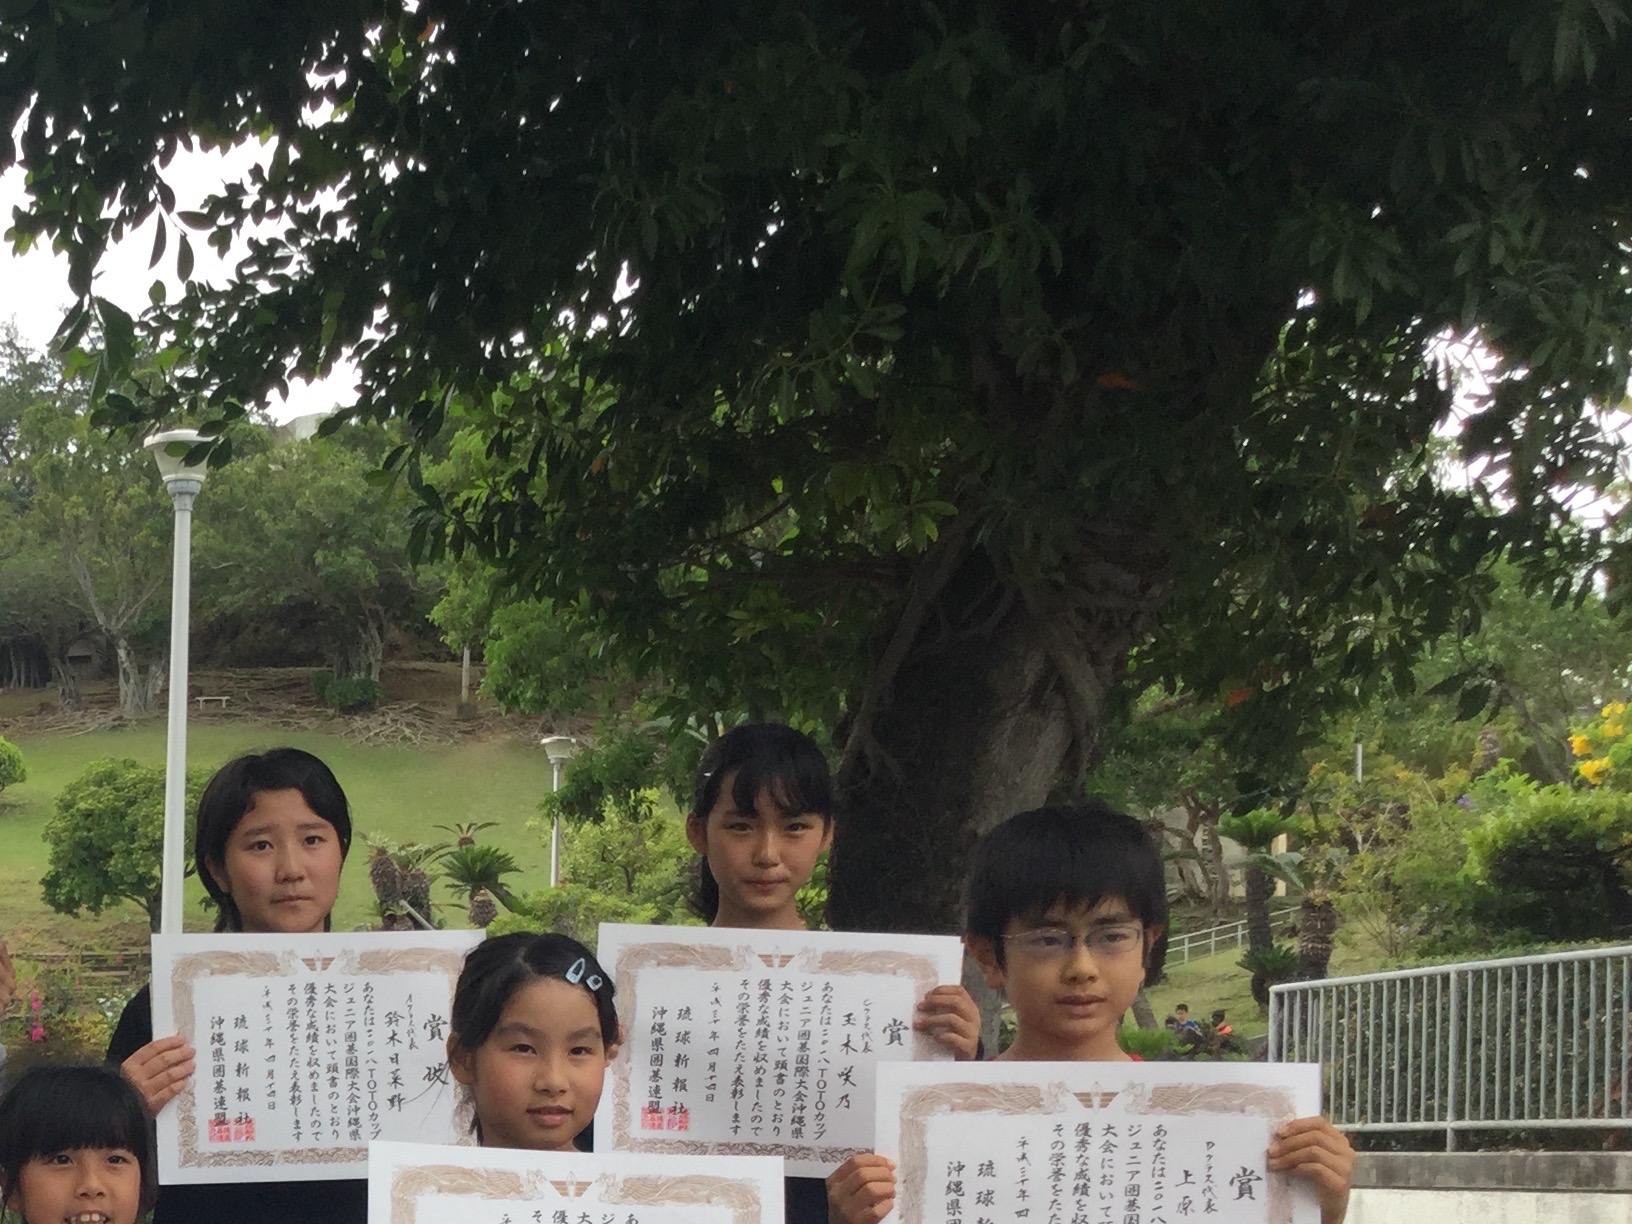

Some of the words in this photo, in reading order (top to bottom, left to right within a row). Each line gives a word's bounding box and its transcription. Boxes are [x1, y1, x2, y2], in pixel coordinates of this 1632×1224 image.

[210, 1016, 227, 1126] 沖縄県囲碁連盟
[234, 1014, 251, 1125] 琉球新報社
[286, 984, 302, 1142] その栄誉をたたえ表彰します
[304, 982, 321, 1142] 優秀な成績を収めましたので
[323, 983, 339, 1140] 大会において頭書のとおり
[344, 984, 362, 1140] ジュニア囲碁国際大会沖縄県
[385, 1011, 404, 1111] 鈴木日菜野
[648, 1006, 667, 1114] 沖縄県囲碁連盟
[671, 1006, 692, 1115] 琉球新報社
[730, 979, 750, 1135] その栄誉をたたえ表彰します
[750, 979, 771, 1136] 優秀な成績を収めましたので
[772, 981, 793, 1137] 大会において頭書のとおり
[791, 982, 812, 1138] ジュニア囲碁国際大会沖縄県
[882, 1018, 909, 1046] 賞
